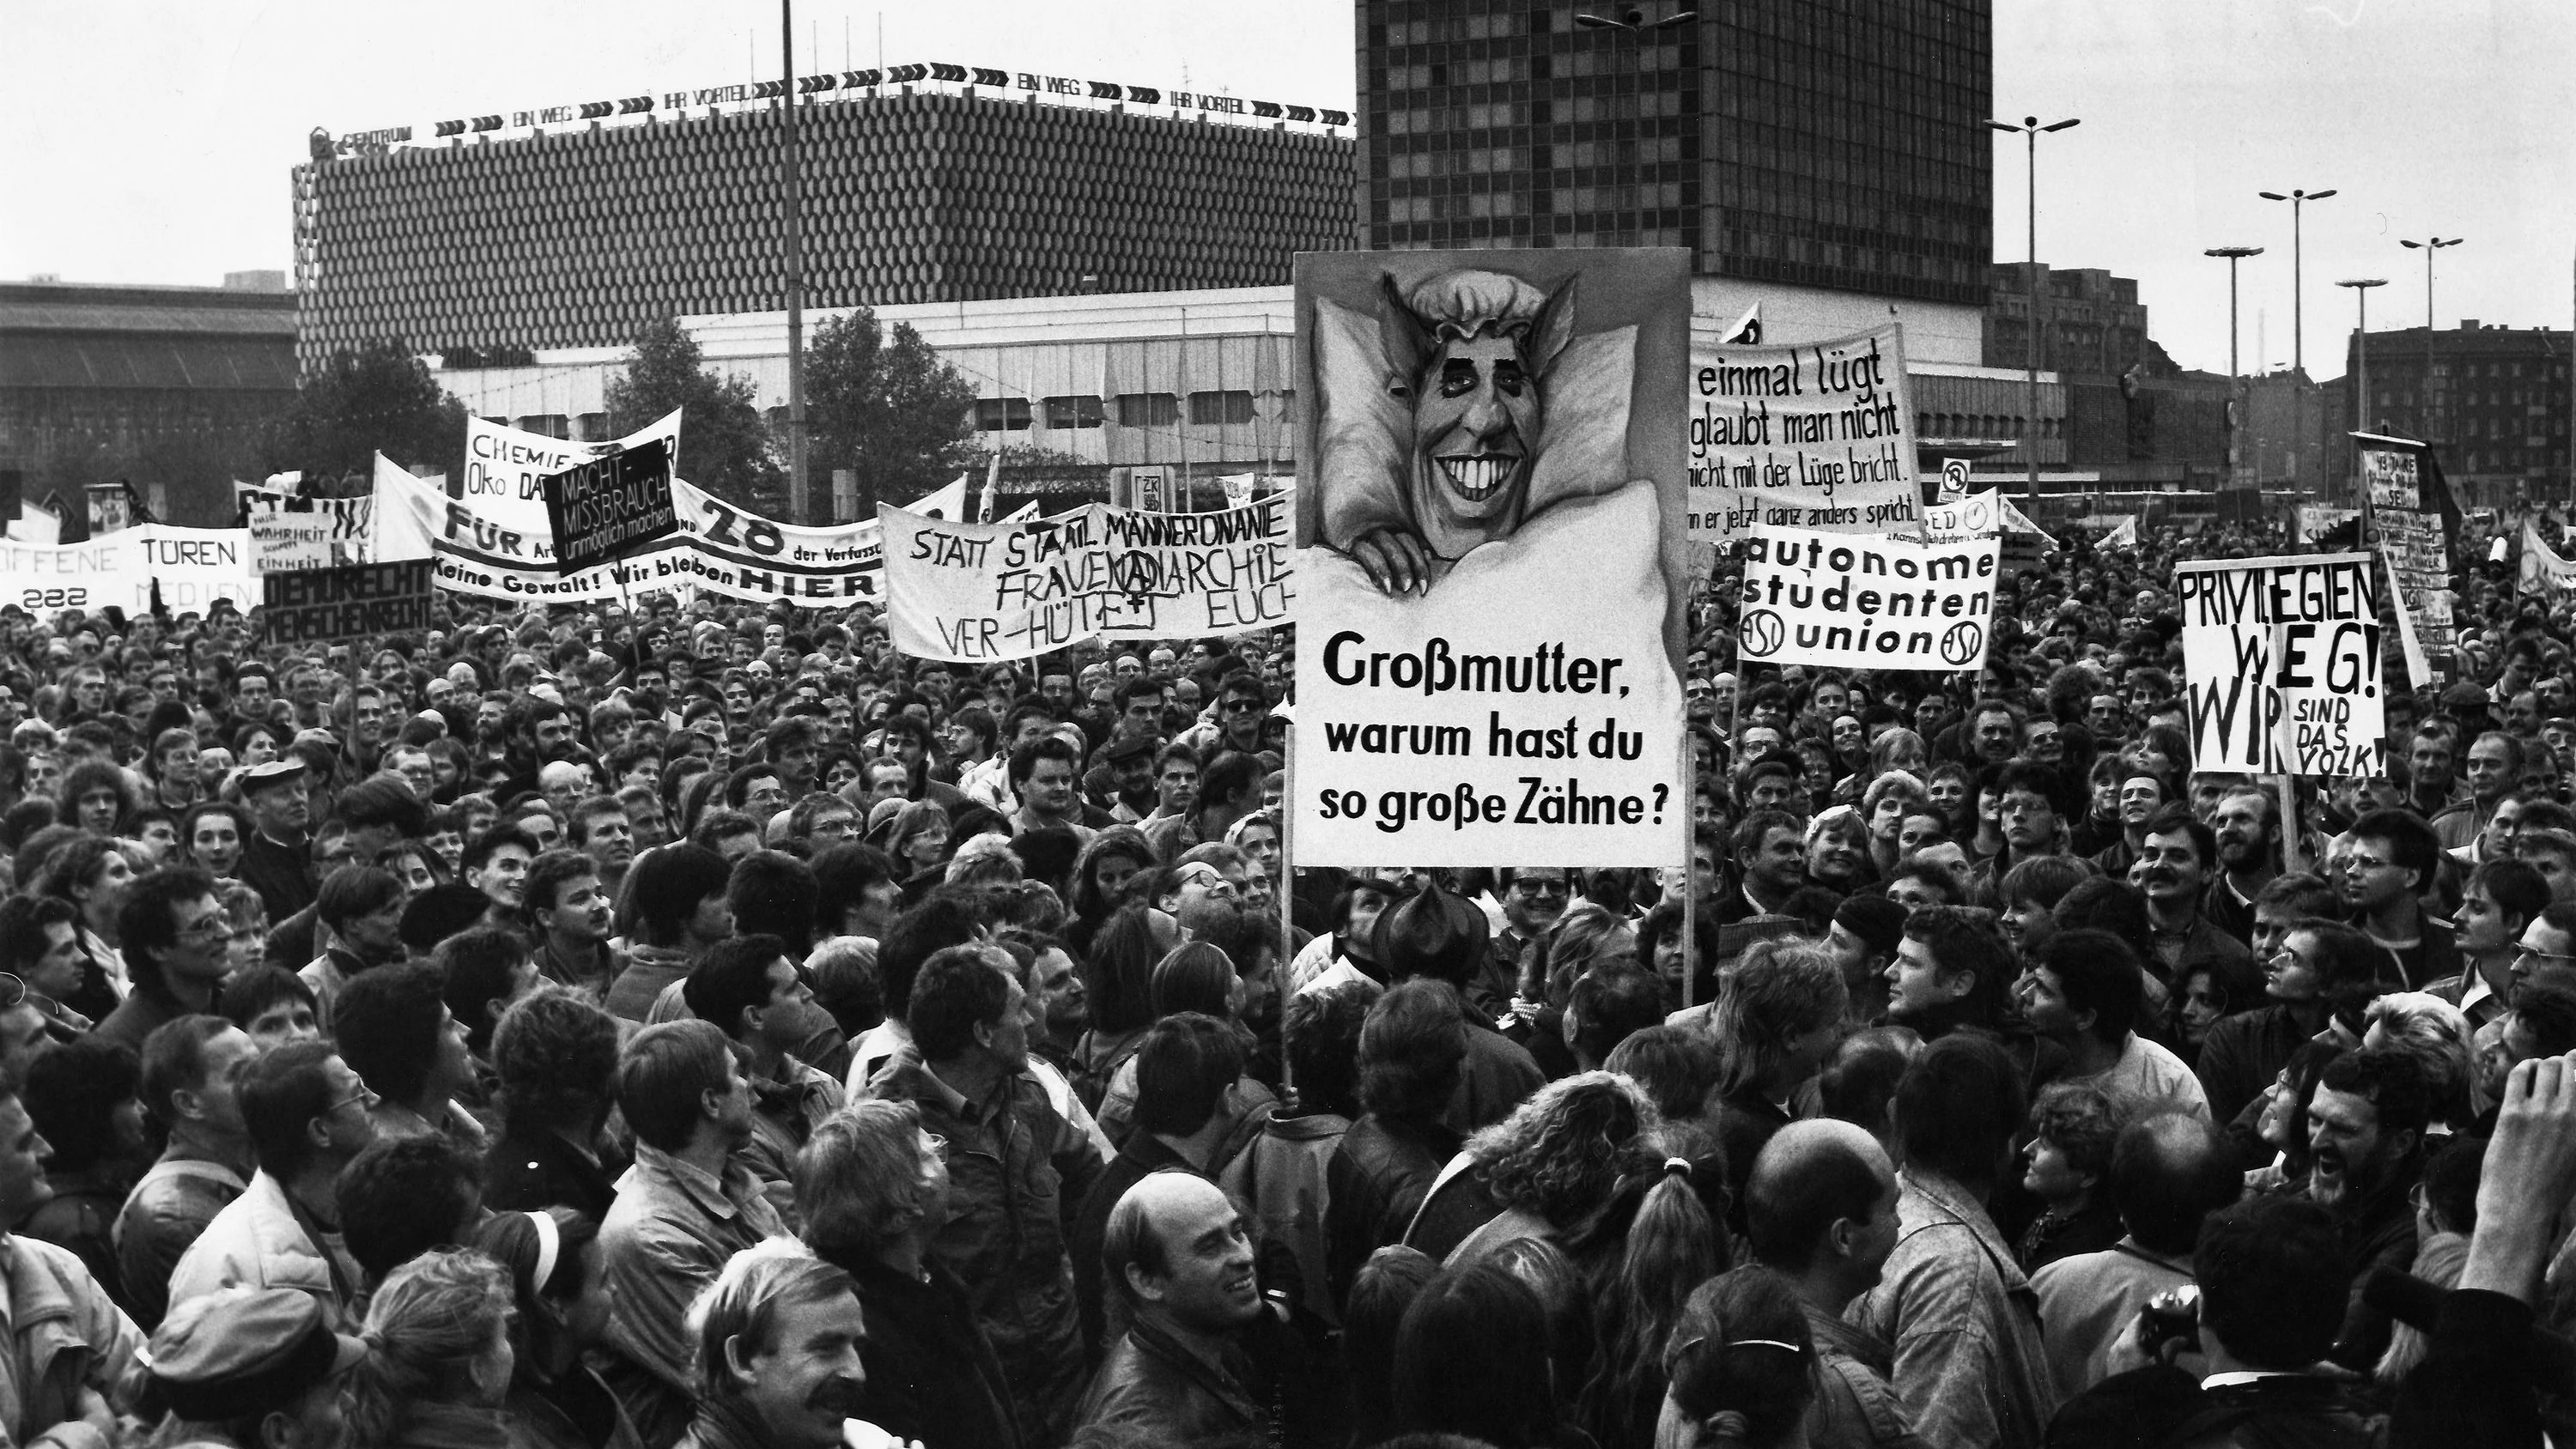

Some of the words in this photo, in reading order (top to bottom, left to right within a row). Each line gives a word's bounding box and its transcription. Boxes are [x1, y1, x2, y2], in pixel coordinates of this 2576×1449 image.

[1018, 73, 1041, 91] EIN
[1046, 76, 1080, 95] WEG
[1170, 91, 1192, 108] IHR
[540, 106, 573, 124] WEG
[343, 126, 412, 148] CENTRUM
[1697, 348, 1802, 397] einmal
[1815, 337, 1884, 403] lügt
[1691, 400, 1771, 458] glaubt
[1783, 411, 1832, 444] man
[1841, 391, 1900, 440] nicht
[1143, 478, 1158, 493] ZK
[1734, 456, 1758, 488] mit
[1764, 452, 1791, 488] der
[1798, 451, 1844, 496] Lüge
[1849, 442, 1908, 482] bricht.
[562, 476, 668, 537] MISSBRAUCH
[1705, 512, 1721, 529] er
[1723, 496, 1759, 535] jetzt
[1807, 497, 1857, 526] anders
[1867, 493, 1917, 530] spricht.
[251, 525, 327, 543] WAHRHEIT
[446, 500, 523, 557] FÜR
[794, 545, 818, 561] der
[564, 520, 624, 560] unmöglich
[627, 506, 673, 538] machen
[909, 528, 995, 569] STATT
[140, 538, 237, 567] TÜREN
[1747, 537, 1994, 581] autonome
[431, 555, 492, 587] Keine
[503, 573, 600, 595] Gewalt!
[610, 563, 650, 586] Wir
[656, 555, 733, 585] bleiben
[738, 568, 878, 598] HIER
[1743, 574, 1990, 617] studenten
[2178, 562, 2378, 627] PRIVILEGIEN
[1795, 618, 1932, 654] union
[1323, 630, 1630, 700] Großmutter,
[2231, 622, 2380, 698] WEG!
[2190, 676, 2287, 774] WIR
[2294, 697, 2349, 724] SIND
[1325, 722, 1471, 756] warum
[1489, 711, 1578, 759] hast
[1588, 718, 1643, 760] du
[2297, 724, 2347, 751] DAS
[1320, 787, 1367, 820] so
[1376, 783, 1506, 833] große
[1514, 776, 1669, 825] Zähne?
